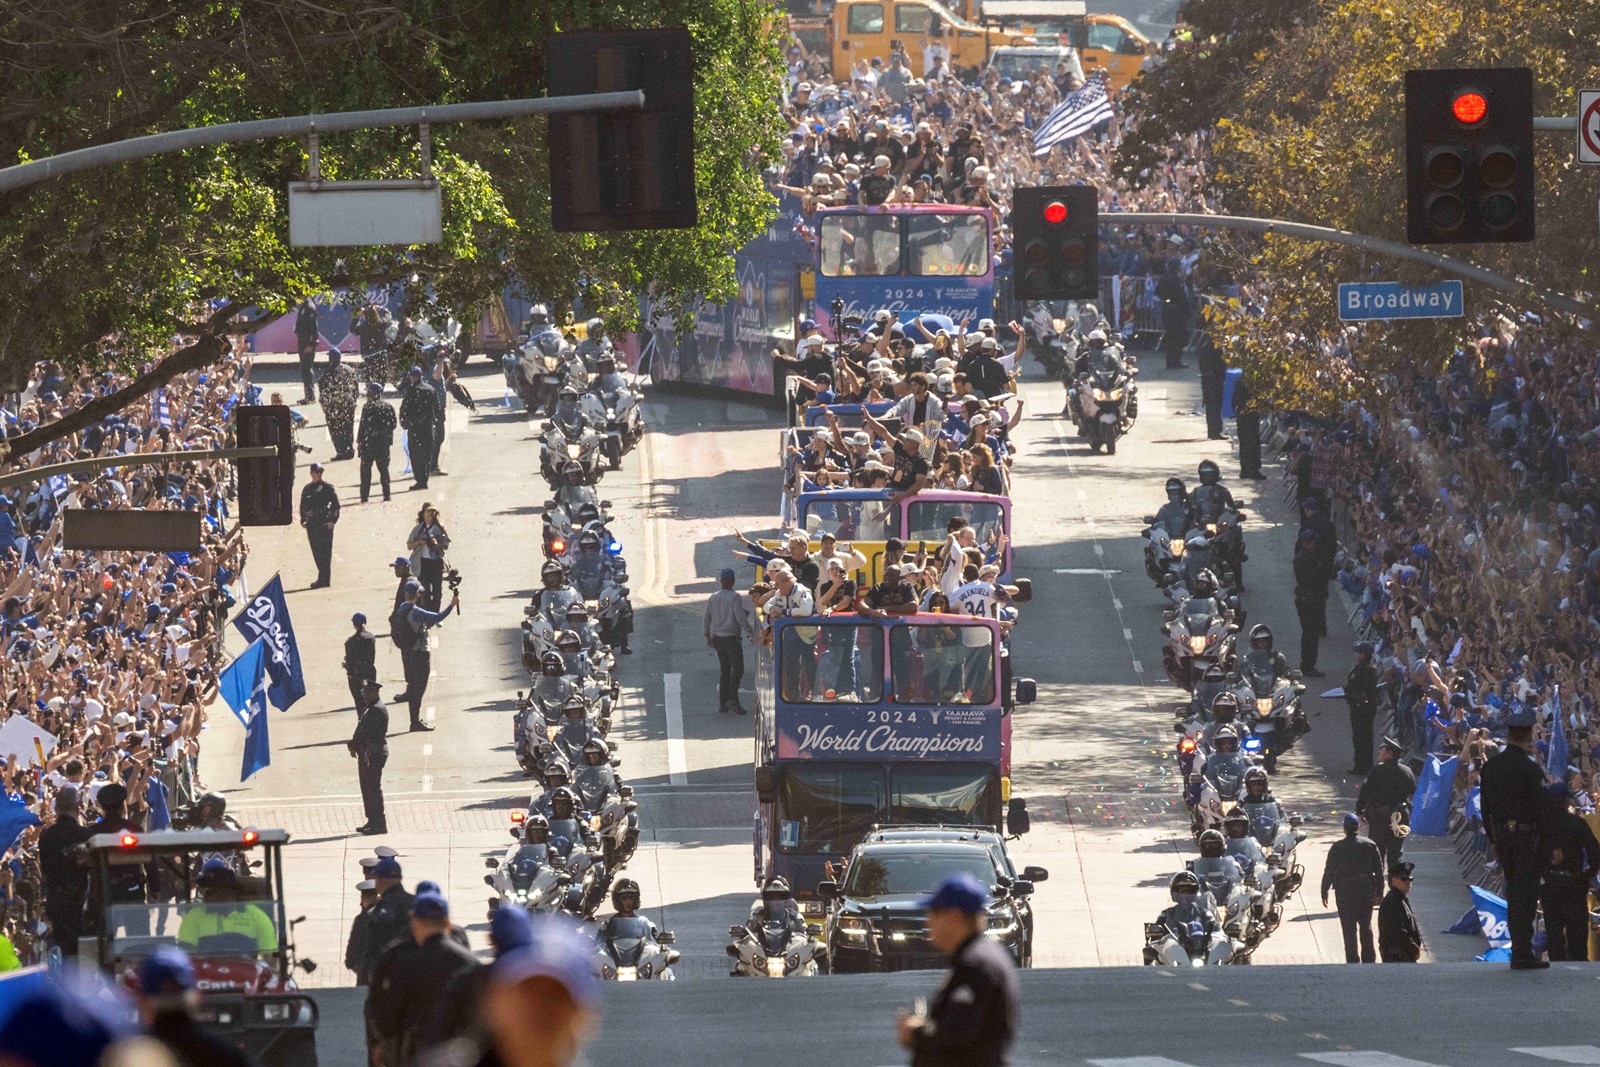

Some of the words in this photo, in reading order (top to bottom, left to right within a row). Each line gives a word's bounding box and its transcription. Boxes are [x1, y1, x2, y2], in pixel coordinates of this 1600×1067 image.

[885, 289, 924, 299] 2024
[1347, 290, 1453, 310] Broadway
[959, 588, 989, 602] VALENZUELA
[965, 599, 986, 617] 34
[867, 711, 917, 723] 2024
[797, 725, 867, 751] World
[865, 725, 984, 758] Champions
[781, 823, 796, 847] 1
